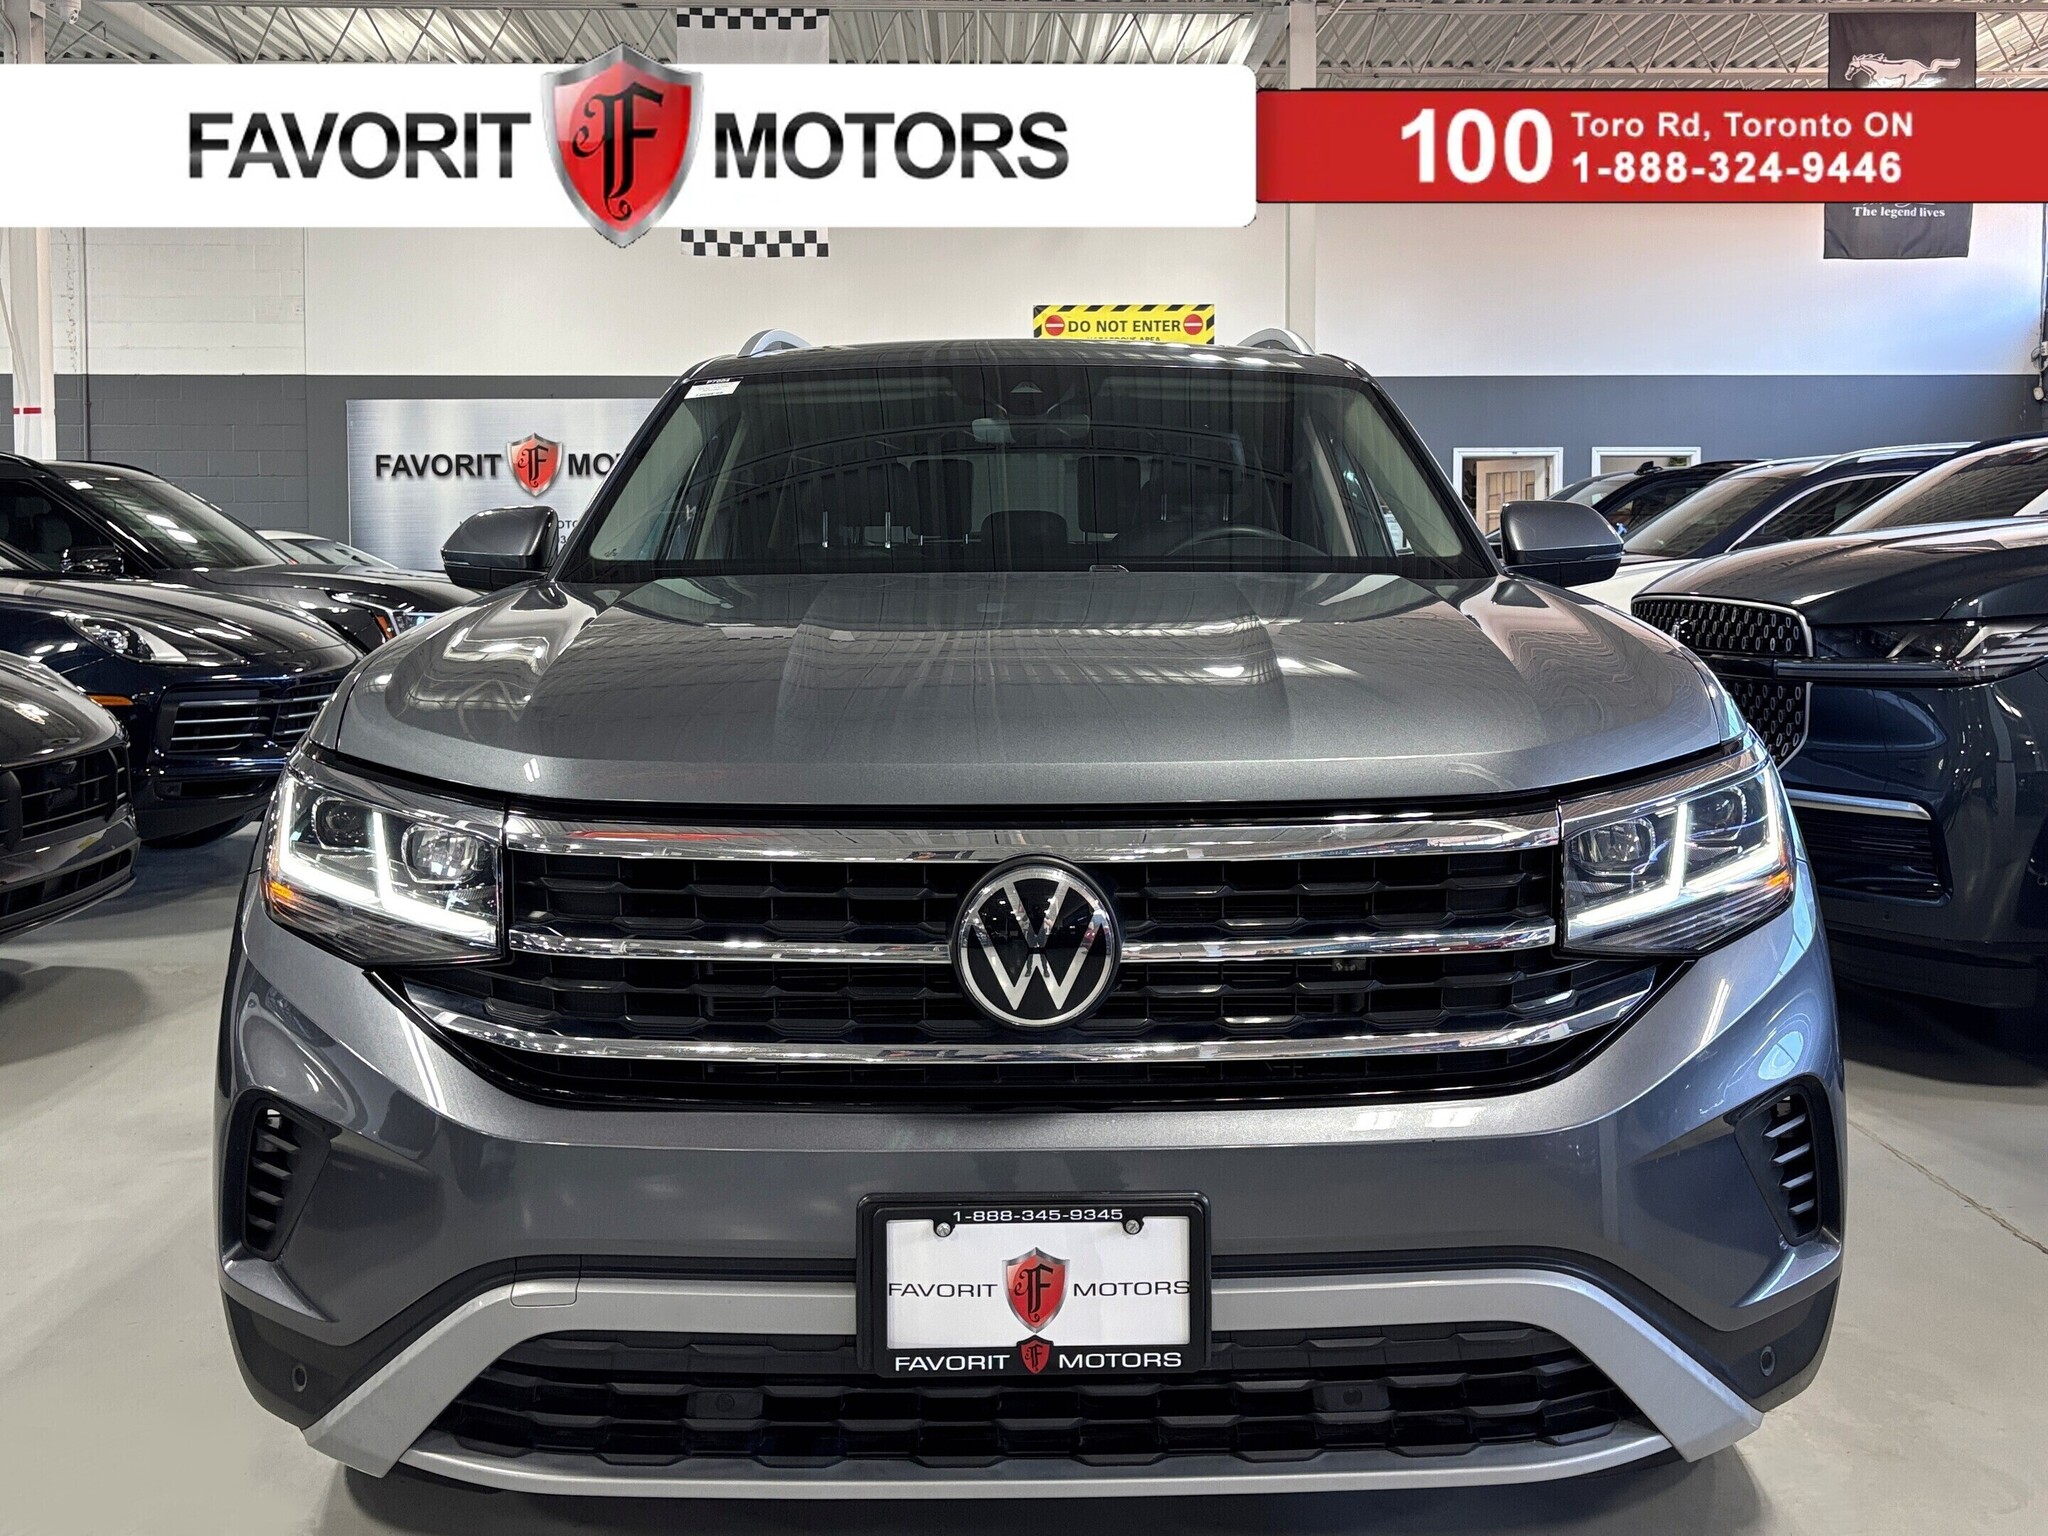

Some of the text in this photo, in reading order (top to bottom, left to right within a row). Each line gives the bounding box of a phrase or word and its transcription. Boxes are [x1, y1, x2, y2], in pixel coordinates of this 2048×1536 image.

[1852, 206, 1946, 219] The legend lives
[1068, 319, 1181, 333] DO NOT ENTER
[375, 453, 502, 478] FAVORIT
[568, 453, 620, 477] MO
[953, 1208, 1124, 1223] 1-888-345-9345
[888, 1282, 998, 1298] FAVORIT
[1073, 1280, 1190, 1297] MOTORS
[895, 1354, 1010, 1372] FAVORIT
[1059, 1351, 1182, 1369] MOTORS
